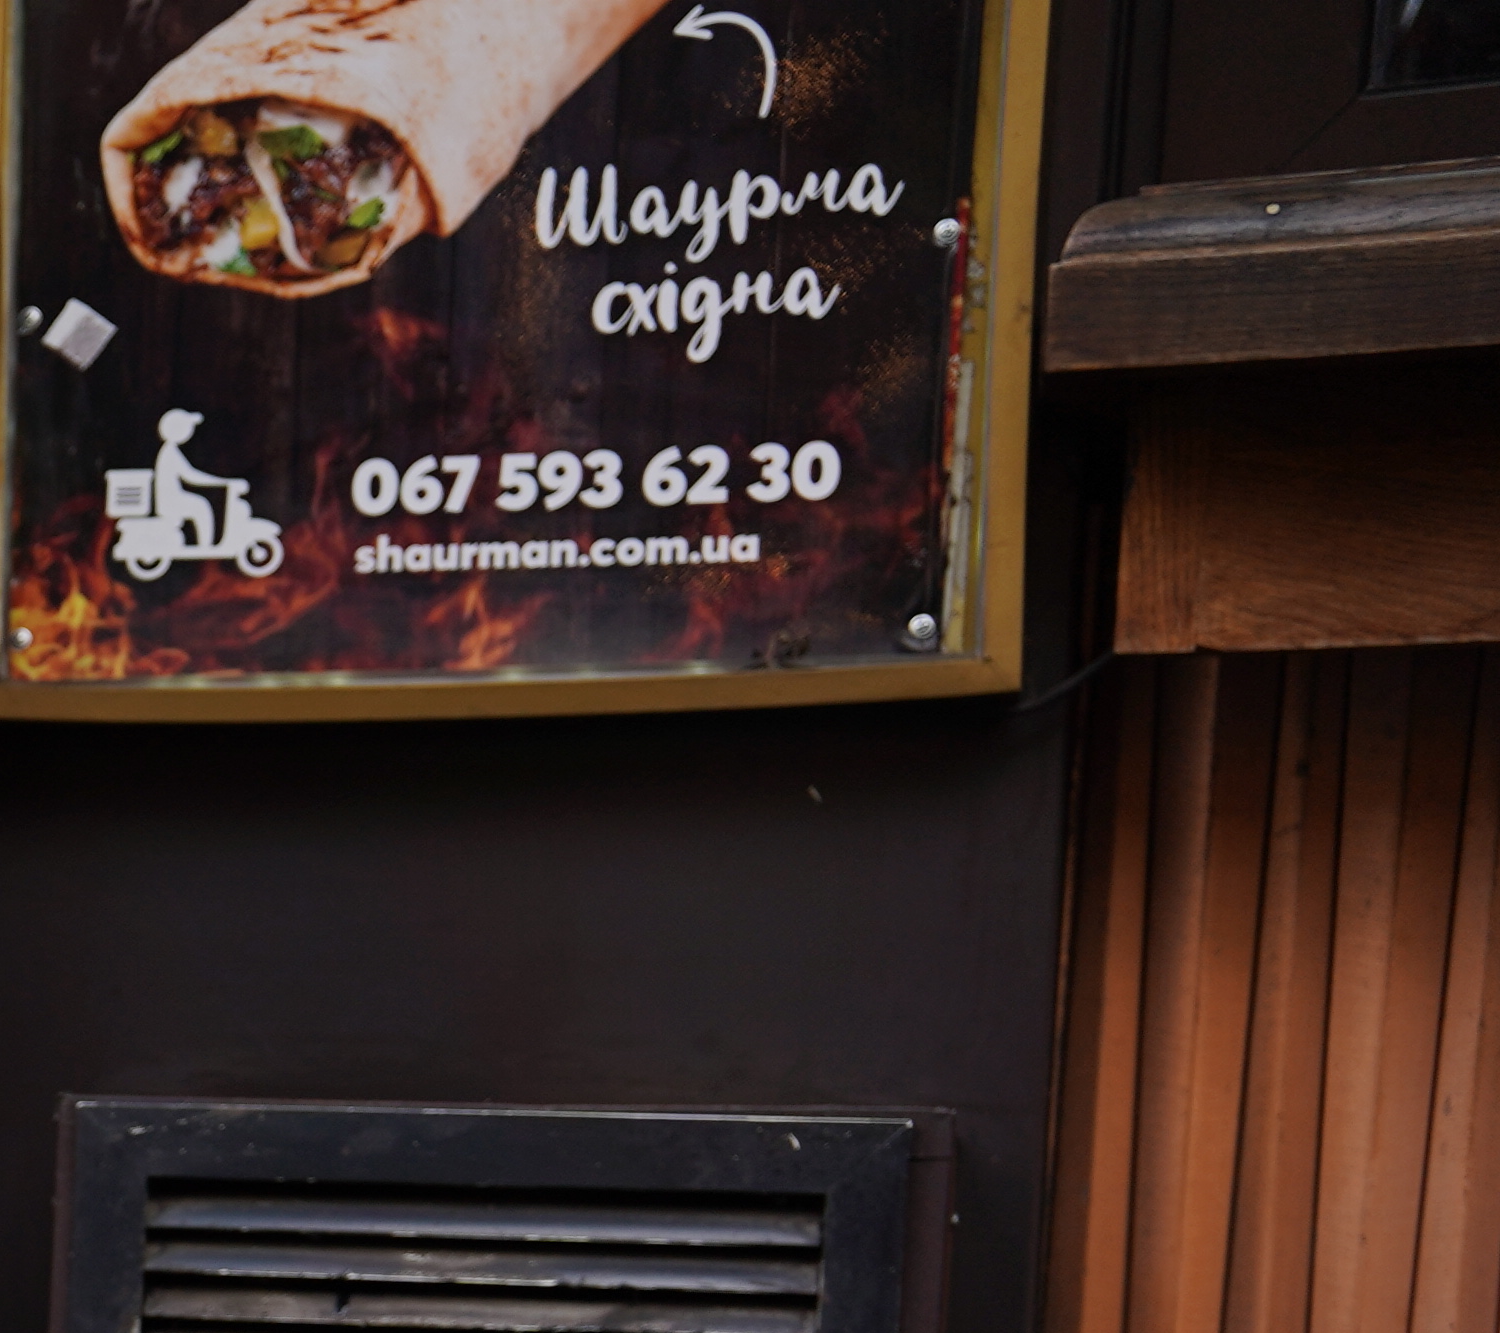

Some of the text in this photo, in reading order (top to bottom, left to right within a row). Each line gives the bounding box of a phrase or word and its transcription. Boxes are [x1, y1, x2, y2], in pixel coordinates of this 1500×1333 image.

[536, 163, 905, 263] Шаурма
[591, 261, 842, 363] східна
[351, 440, 842, 517] 067 593 62 30
[353, 532, 761, 575] shaurman.com.ua
